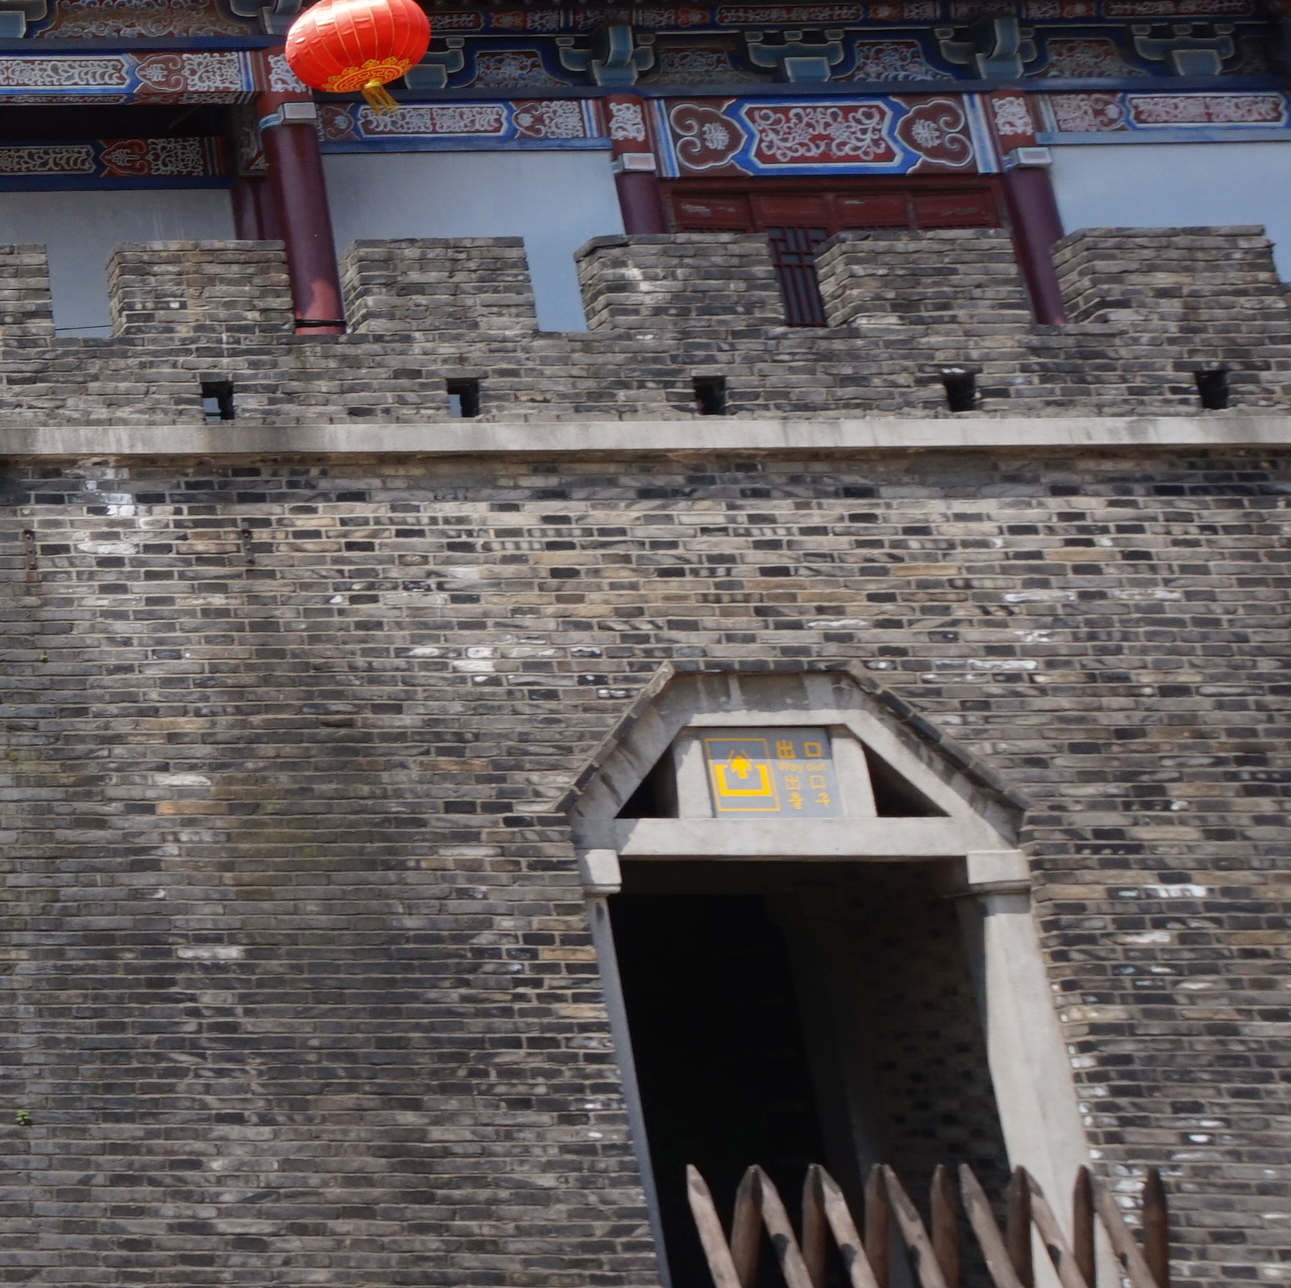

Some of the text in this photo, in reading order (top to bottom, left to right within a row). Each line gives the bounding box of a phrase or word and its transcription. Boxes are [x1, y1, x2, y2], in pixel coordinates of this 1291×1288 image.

[774, 739, 823, 759] 出口
[777, 761, 826, 773] Way out
[783, 774, 826, 790] 出口
